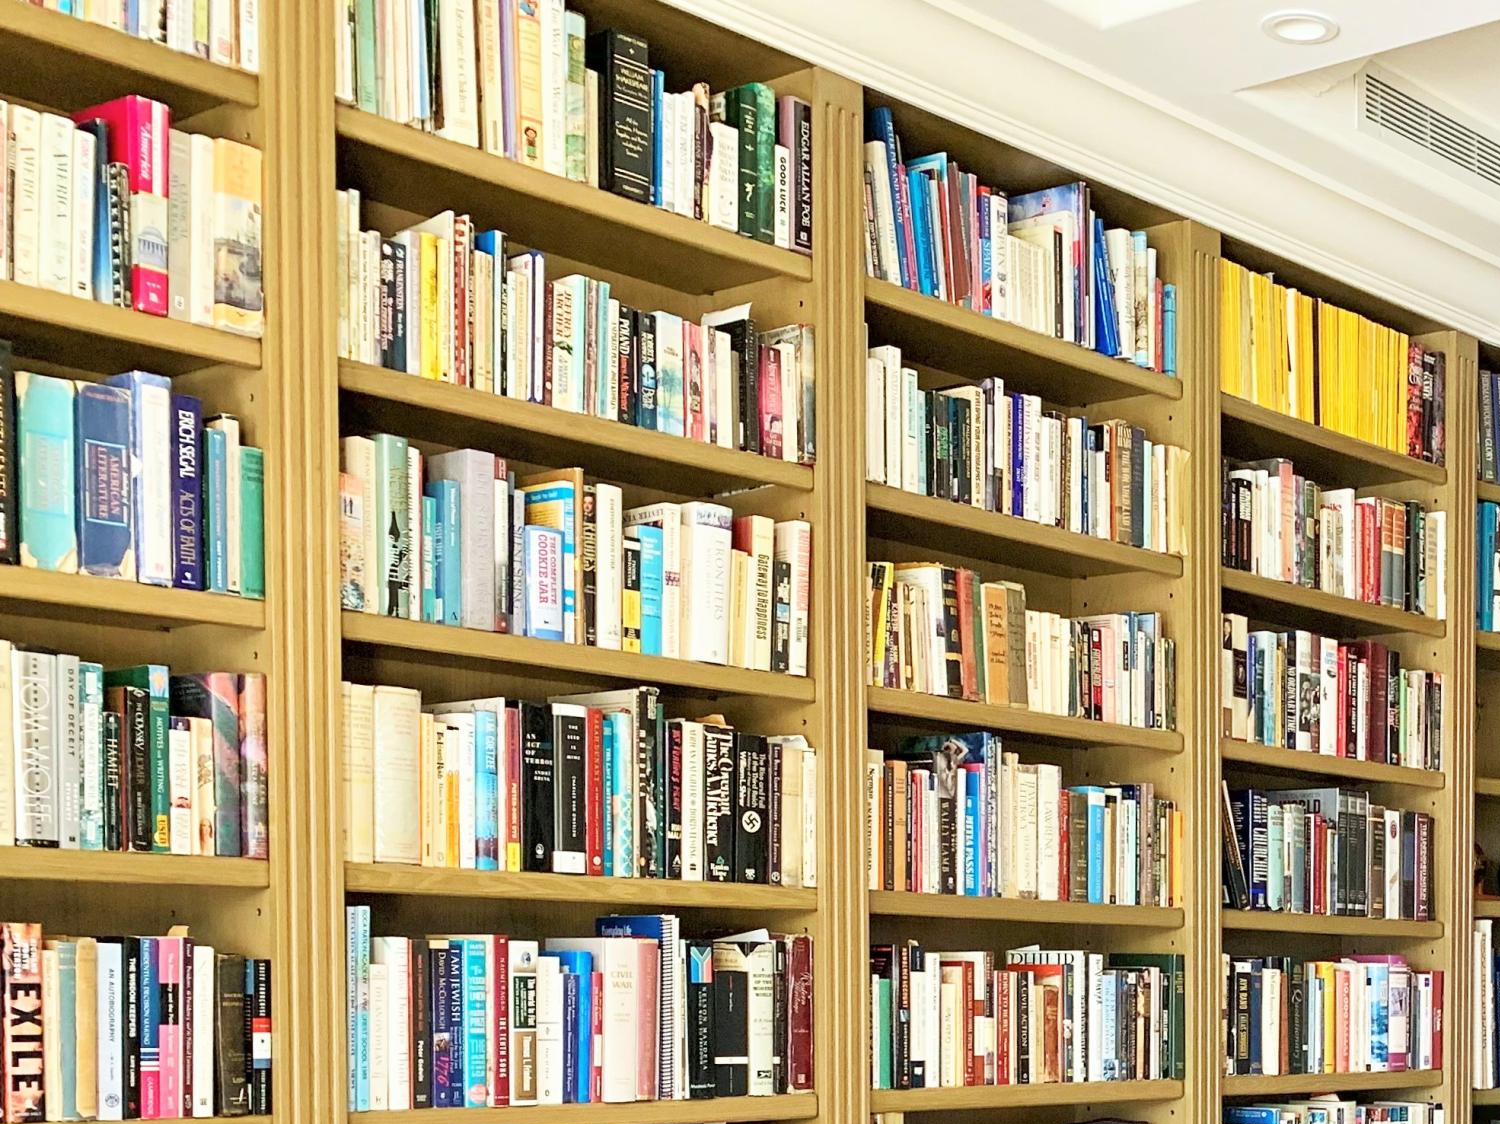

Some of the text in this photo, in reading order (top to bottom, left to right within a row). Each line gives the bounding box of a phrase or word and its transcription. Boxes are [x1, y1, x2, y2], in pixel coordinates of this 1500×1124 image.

[800, 121, 811, 227] EDGAR ALLAN POE
[888, 147, 897, 164] PAN
[890, 167, 898, 187] AND
[779, 156, 788, 213] GOOD LUCK
[619, 318, 630, 354] POLAND
[620, 355, 629, 374] James
[97, 447, 109, 519] LITERATURE
[109, 455, 121, 514] AMERICAN
[178, 410, 196, 565] ERICH SEGAL ACTS OF FAITH
[537, 534, 549, 604] COOKIE JAR
[582, 521, 596, 572] RHODES
[757, 554, 769, 586] Gateway
[550, 556, 558, 605] COMPLETE
[755, 598, 770, 640] Happiness
[20, 674, 49, 733] TOM
[68, 694, 75, 710] OF
[1287, 676, 1296, 711] ORDINARY
[133, 712, 146, 749] ODYSSEY
[1287, 713, 1296, 732] TIME
[106, 738, 118, 789] HAMLET
[156, 717, 165, 793] MOTIVES WRITING
[718, 732, 734, 815] The Covenant
[704, 730, 721, 846] James A. Michener
[159, 819, 167, 844] USED
[940, 801, 950, 873] WALLY LAMB
[1253, 827, 1267, 883] CHURCHILL
[108, 968, 115, 979] AN
[450, 956, 461, 1022] AM JEWISH
[11, 982, 42, 1093] EXILE
[128, 1004, 136, 1037] KEEPERS
[436, 1056, 449, 1087] 1776
[499, 1017, 507, 1078] THE TENTH SONG
